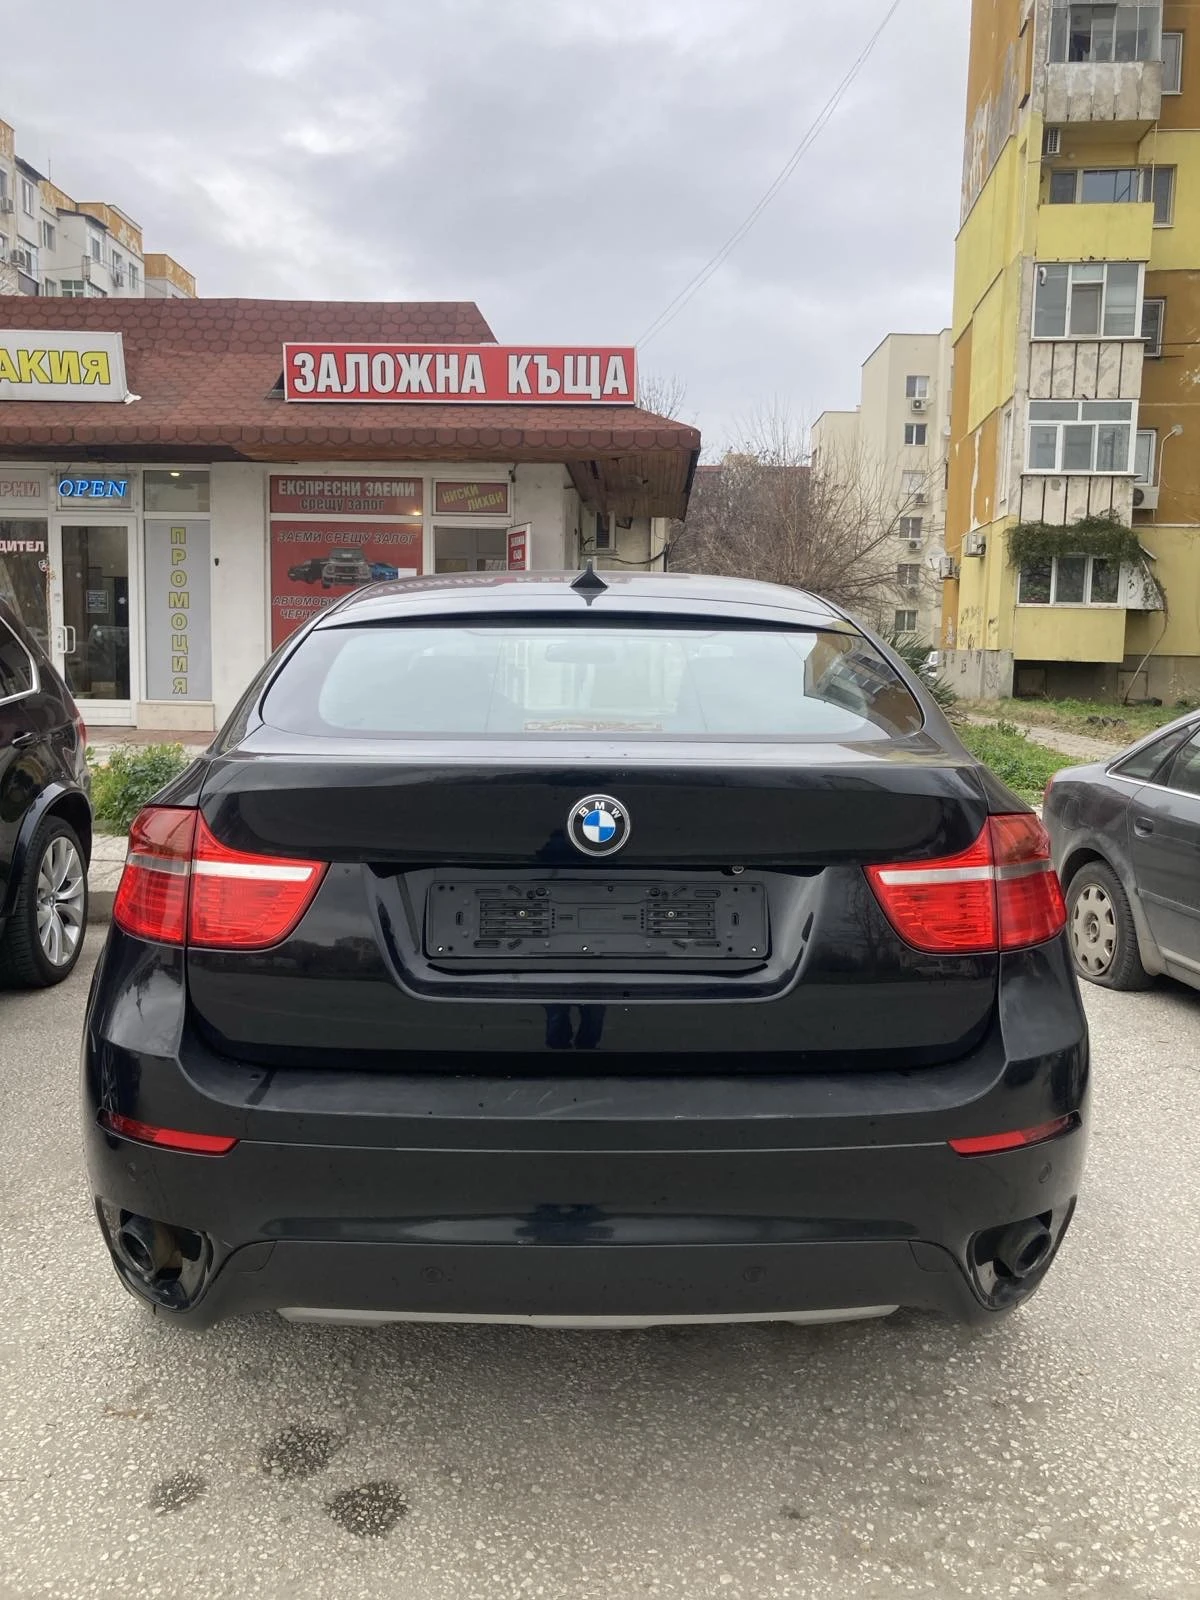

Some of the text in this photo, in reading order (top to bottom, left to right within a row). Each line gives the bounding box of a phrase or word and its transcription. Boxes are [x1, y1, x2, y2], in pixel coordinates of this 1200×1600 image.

[293, 352, 630, 400] ЗАЛОЖНА КЪЩА
[58, 479, 128, 498] OPEN
[278, 479, 416, 497] ЕКСПРЕСНИ ЗАЕМИ
[441, 484, 480, 505] НИСКИ
[467, 491, 504, 512] ЛИХВИ
[277, 530, 418, 546] ЗАЕМИ СРЕЩУ ЗАЛОГ
[168, 526, 190, 695] ПРОМОЦИЯ
[578, 801, 622, 819] BMW
